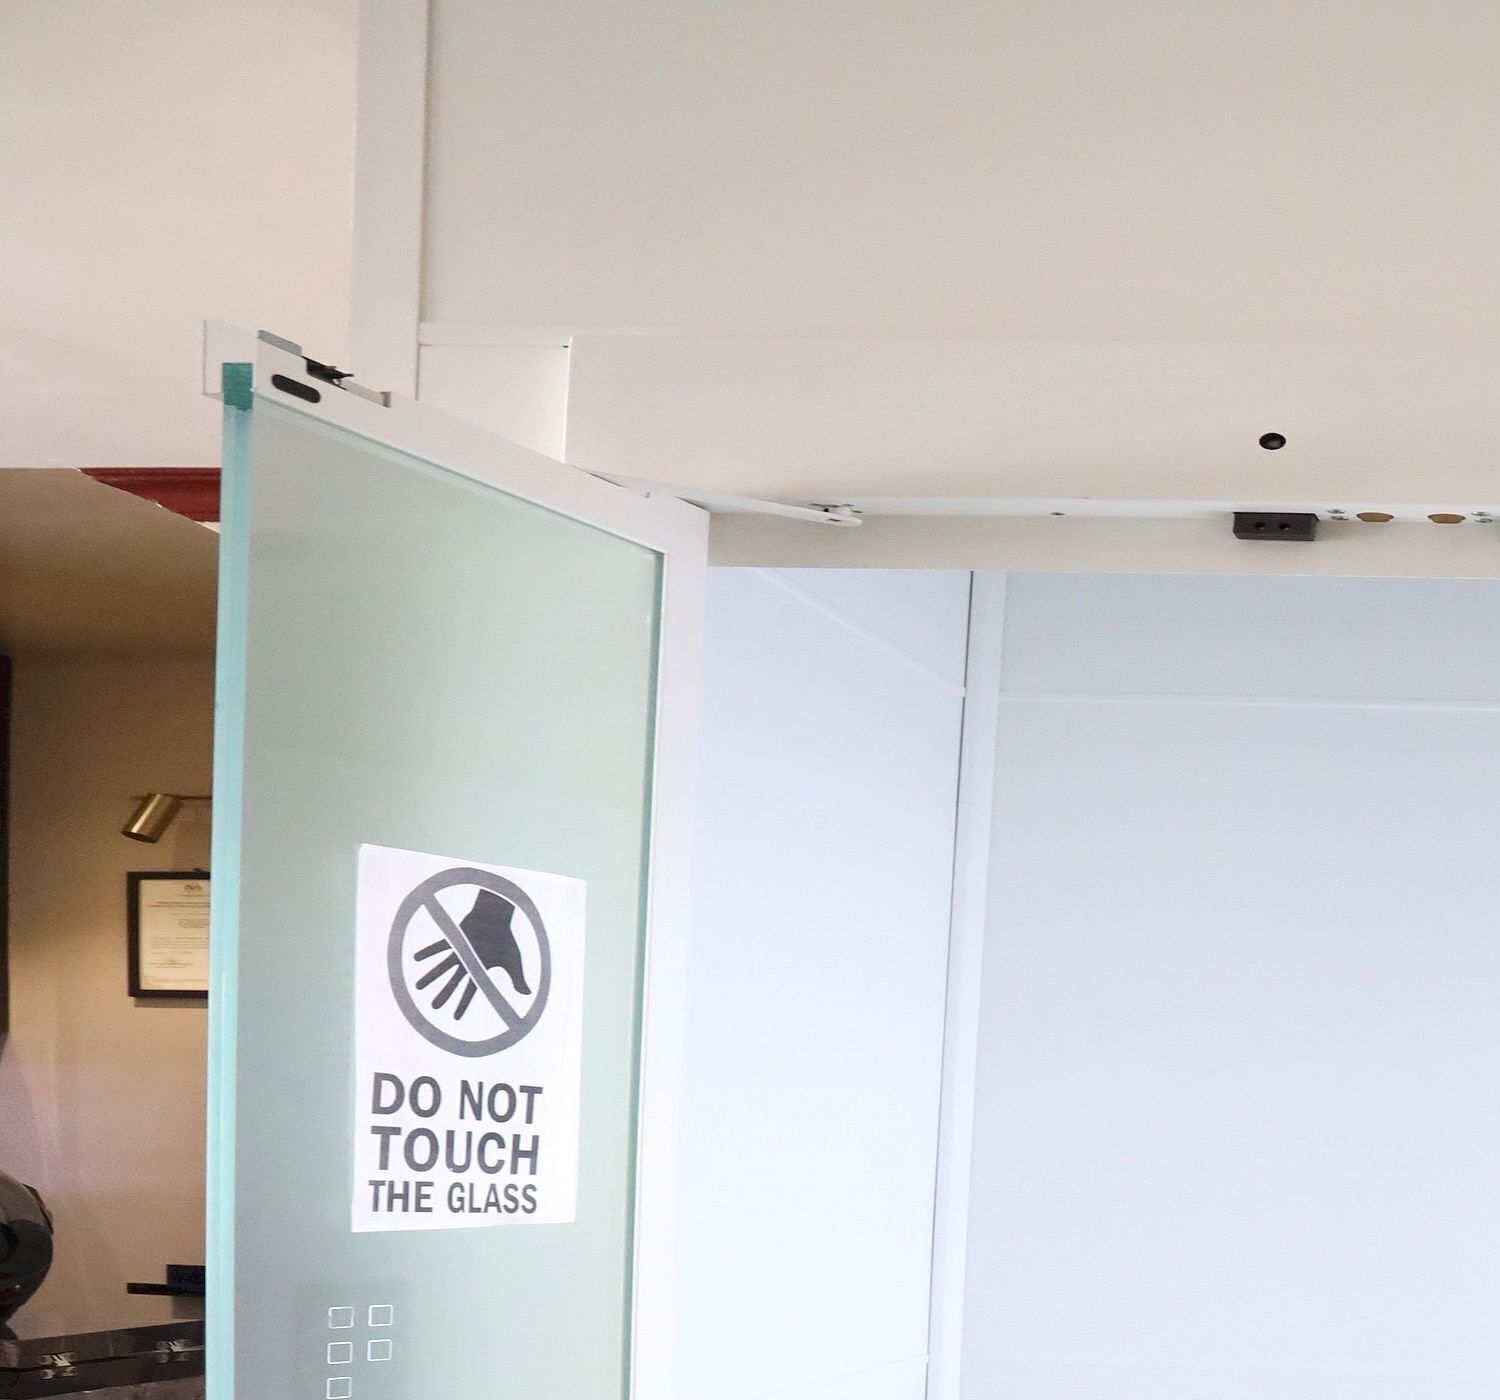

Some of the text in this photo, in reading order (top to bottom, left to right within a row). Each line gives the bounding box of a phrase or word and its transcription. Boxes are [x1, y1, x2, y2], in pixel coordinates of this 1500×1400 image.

[371, 1072, 543, 1124] DO NOT
[370, 1125, 540, 1176] TOUCH
[368, 1179, 538, 1214] THE GLASS
